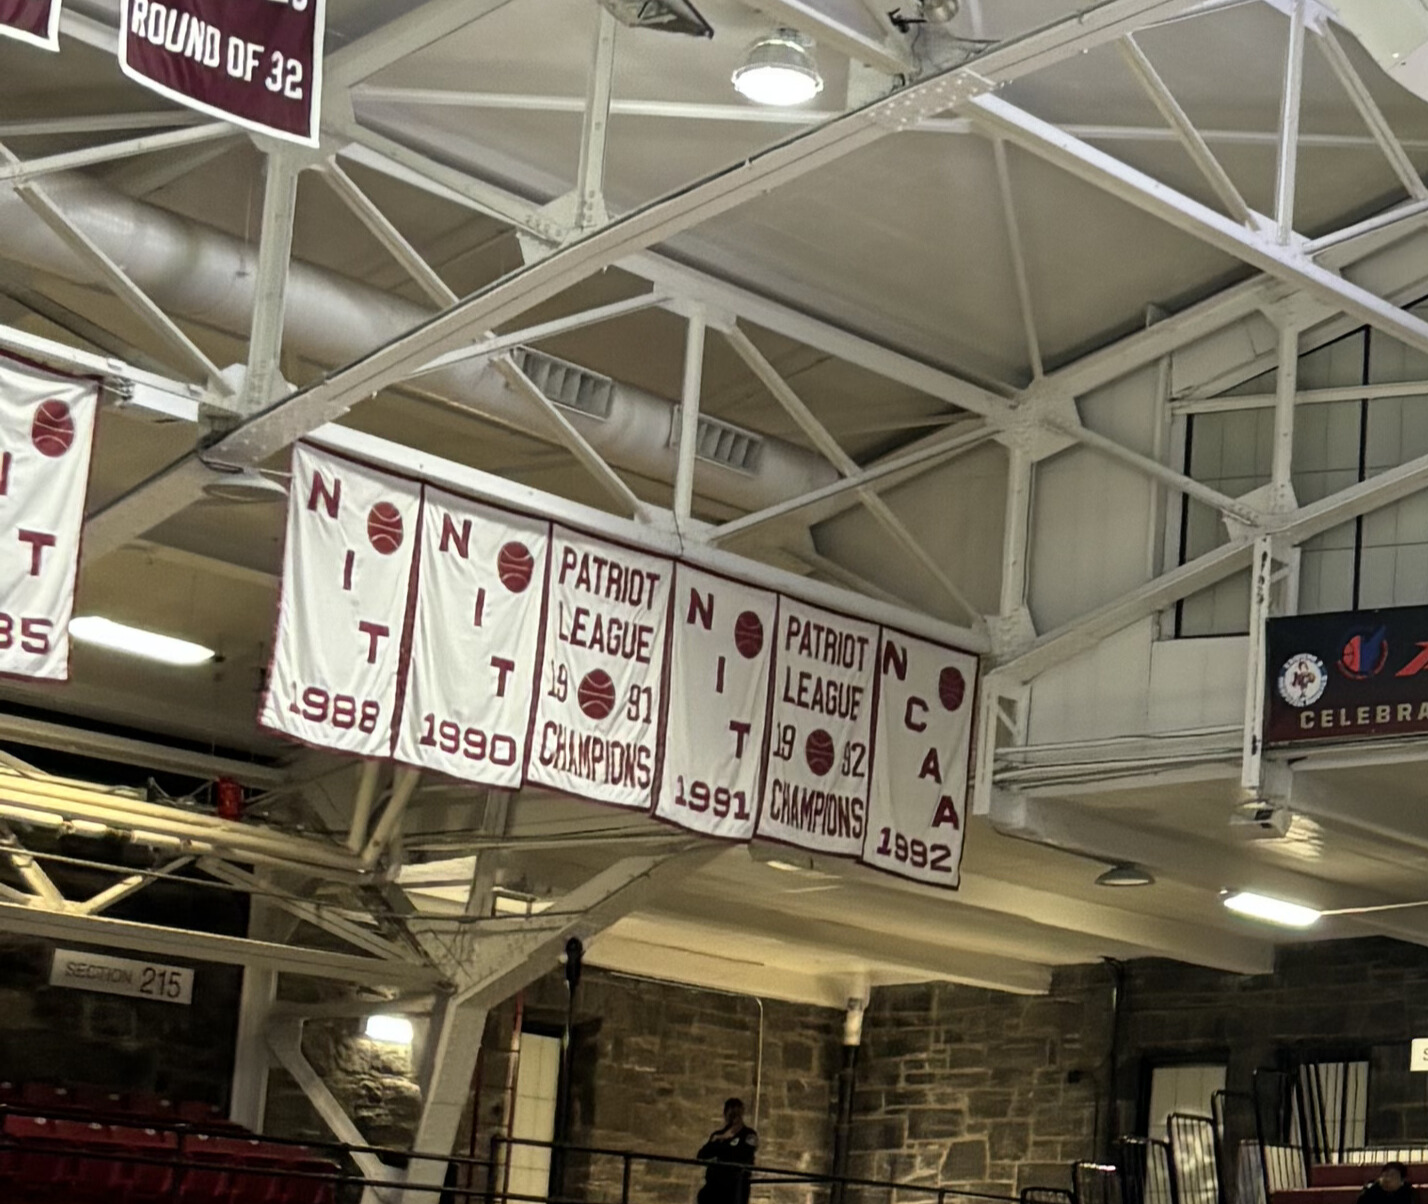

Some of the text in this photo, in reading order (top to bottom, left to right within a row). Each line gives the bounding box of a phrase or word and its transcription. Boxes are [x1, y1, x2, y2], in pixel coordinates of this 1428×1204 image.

[131, 0, 304, 100] ROUND OF 32
[558, 546, 661, 611] PATRIOT
[558, 603, 654, 664] LEAGUE
[785, 615, 869, 672] PATRIOT
[288, 681, 381, 734] 1988
[547, 659, 653, 724] 19 91
[782, 665, 864, 722] LEAGUE
[419, 712, 517, 767] 1990
[538, 720, 652, 790] CHAMPIONS
[773, 722, 867, 778] 19 92
[675, 775, 751, 821] 1991
[770, 778, 865, 839] CHAMPIONS
[876, 827, 953, 873] 1992
[65, 961, 182, 998] SECTION 215
